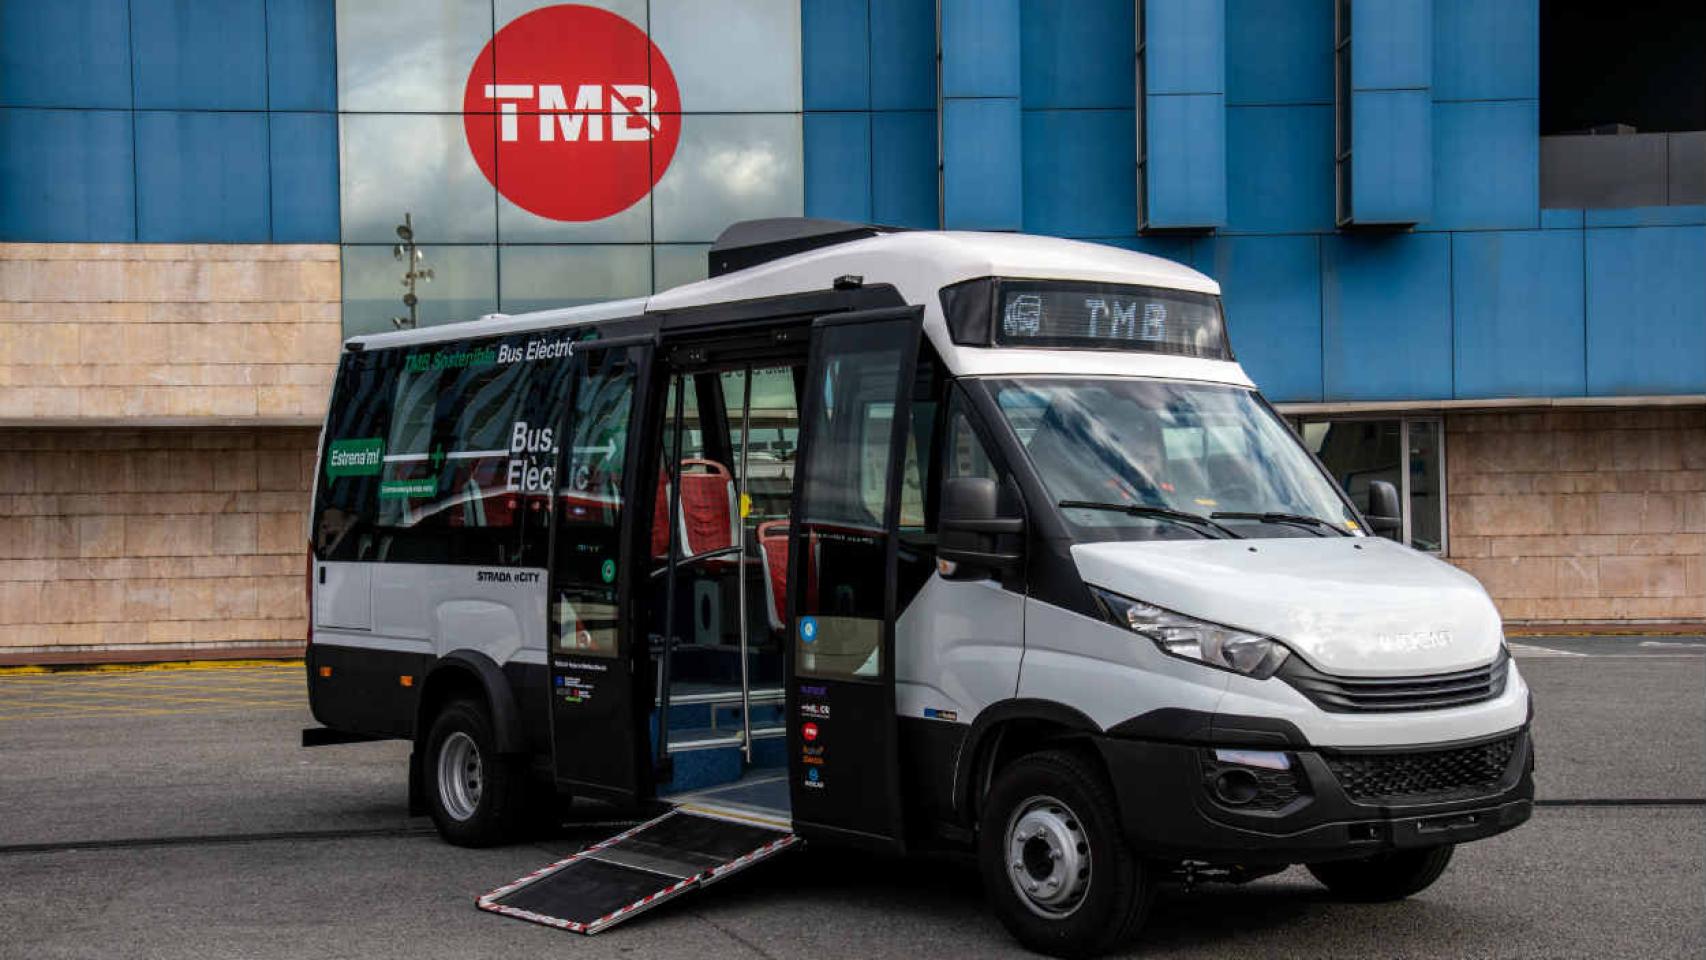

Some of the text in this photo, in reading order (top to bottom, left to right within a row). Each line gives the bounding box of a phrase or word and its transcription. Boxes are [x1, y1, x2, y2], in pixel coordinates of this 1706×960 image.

[485, 84, 660, 142] TMB
[1086, 299, 1168, 341] TMB
[497, 344, 523, 364] Bus
[525, 337, 575, 360] Elèctric
[477, 571, 511, 583] STRADA
